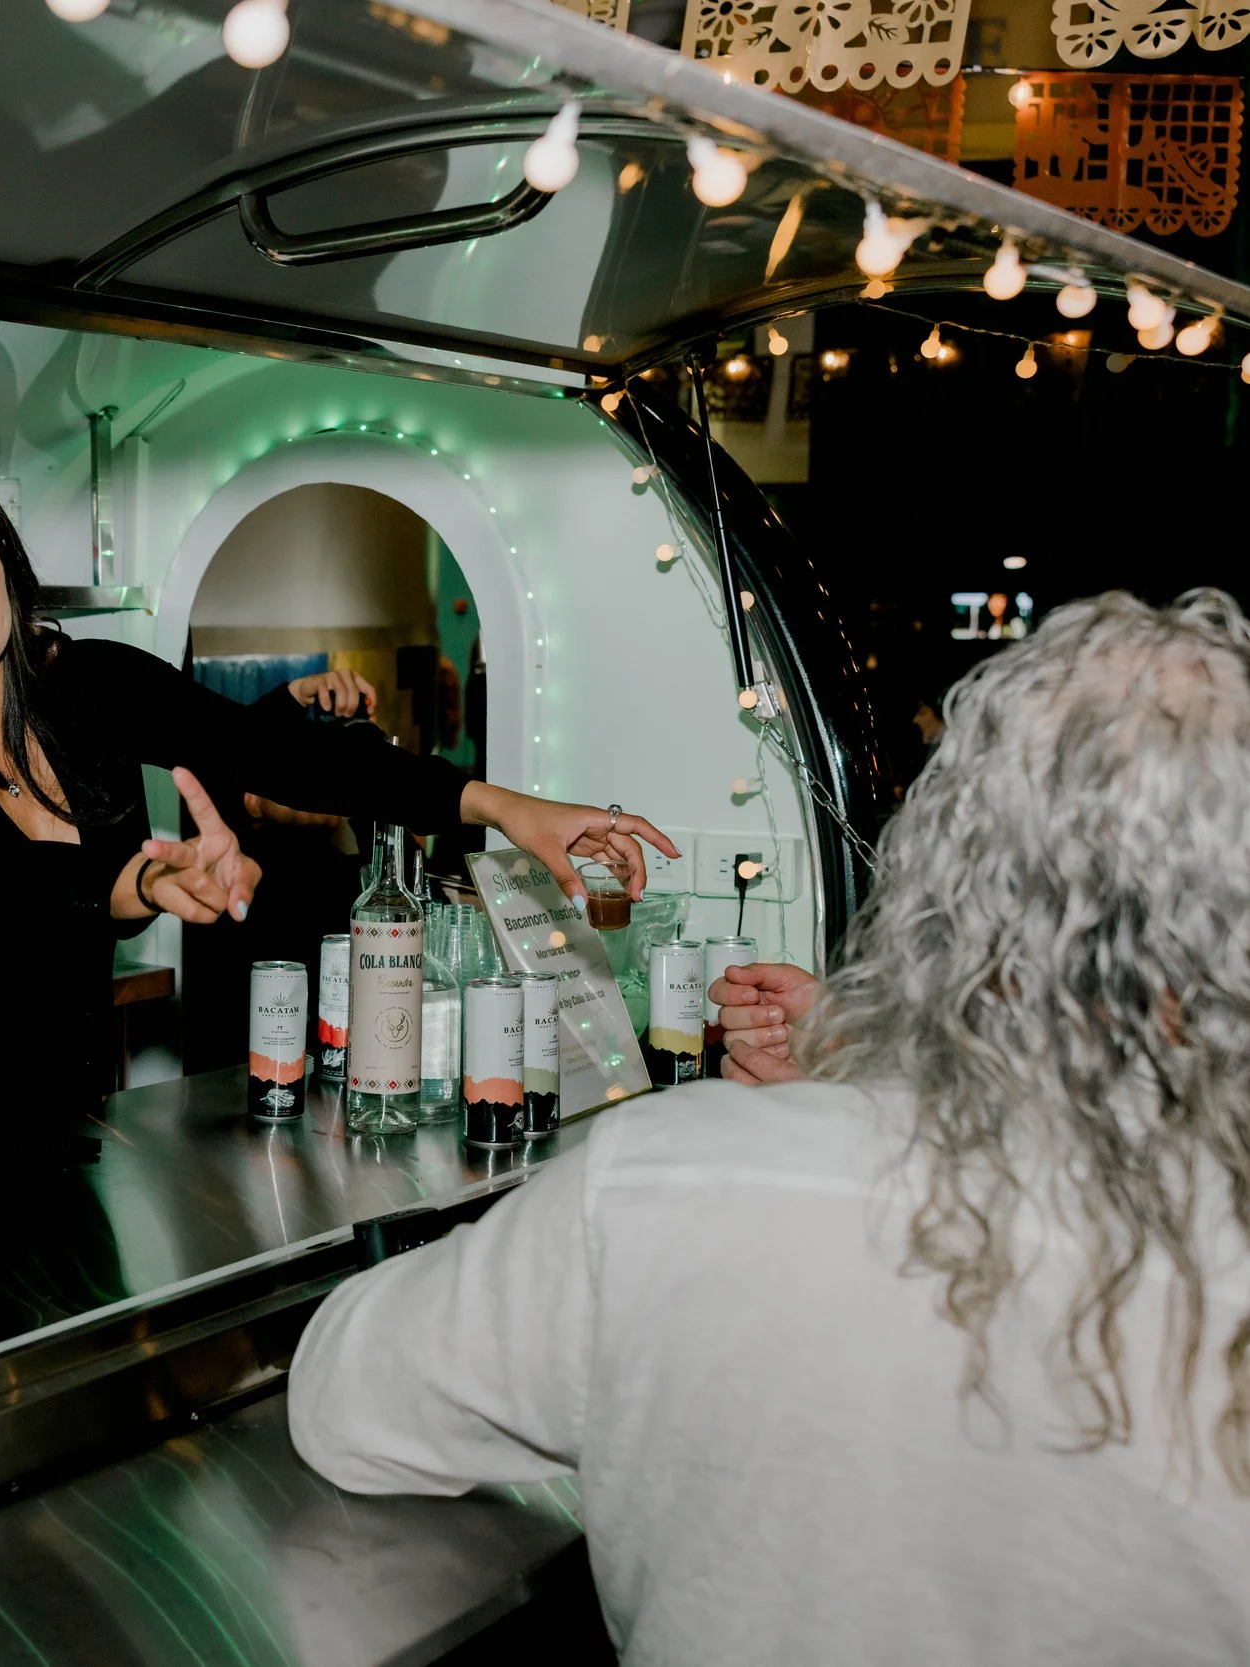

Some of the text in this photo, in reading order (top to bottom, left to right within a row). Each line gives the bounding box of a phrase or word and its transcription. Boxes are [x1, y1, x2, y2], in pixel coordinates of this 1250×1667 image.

[529, 868, 551, 886] Bar
[504, 904, 583, 931] Bacanora Tasting
[360, 954, 385, 969] COLA
[258, 1006, 299, 1014] BACATAM
